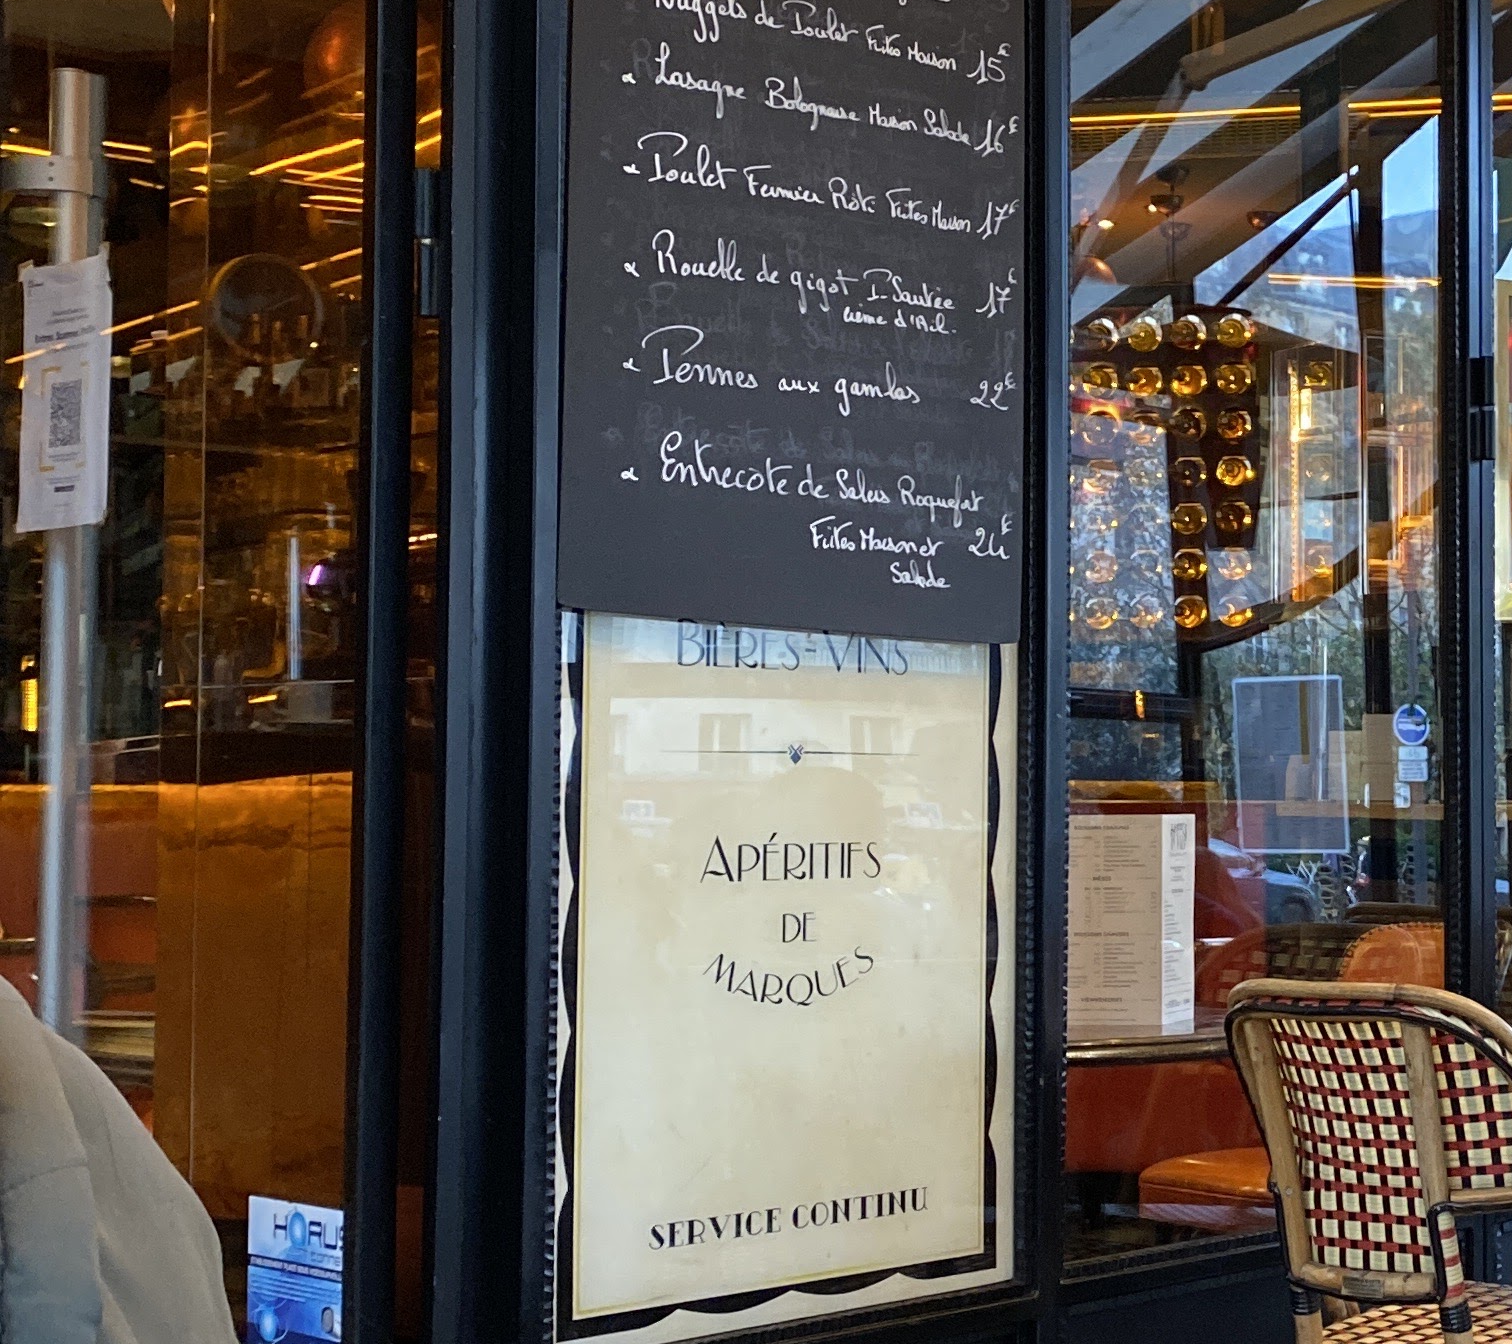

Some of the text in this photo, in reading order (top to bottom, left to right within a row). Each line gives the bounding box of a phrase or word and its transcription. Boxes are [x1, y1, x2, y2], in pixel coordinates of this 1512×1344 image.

[754, 0, 785, 29] de
[781, 0, 859, 43] Poulet
[907, 40, 957, 71] Maison
[654, 41, 747, 119] Lasagne
[868, 102, 918, 132] Maison
[923, 107, 972, 147] Salade
[637, 131, 738, 190] Poulet
[931, 198, 972, 234] Maison
[651, 228, 746, 282] Rouelle
[755, 252, 781, 284] de
[789, 268, 860, 315] gigot
[641, 324, 759, 390] Pennes
[777, 377, 821, 394] aux
[834, 361, 921, 418] gambas
[796, 462, 831, 499] de
[859, 526, 917, 555] Maison
[918, 536, 945, 557] et
[889, 558, 951, 589] Salade
[700, 831, 882, 884] APÉRITIFS
[781, 910, 817, 944] DE
[703, 945, 875, 1007] MARQUES
[649, 1185, 929, 1251] SERVICE CONTINU
